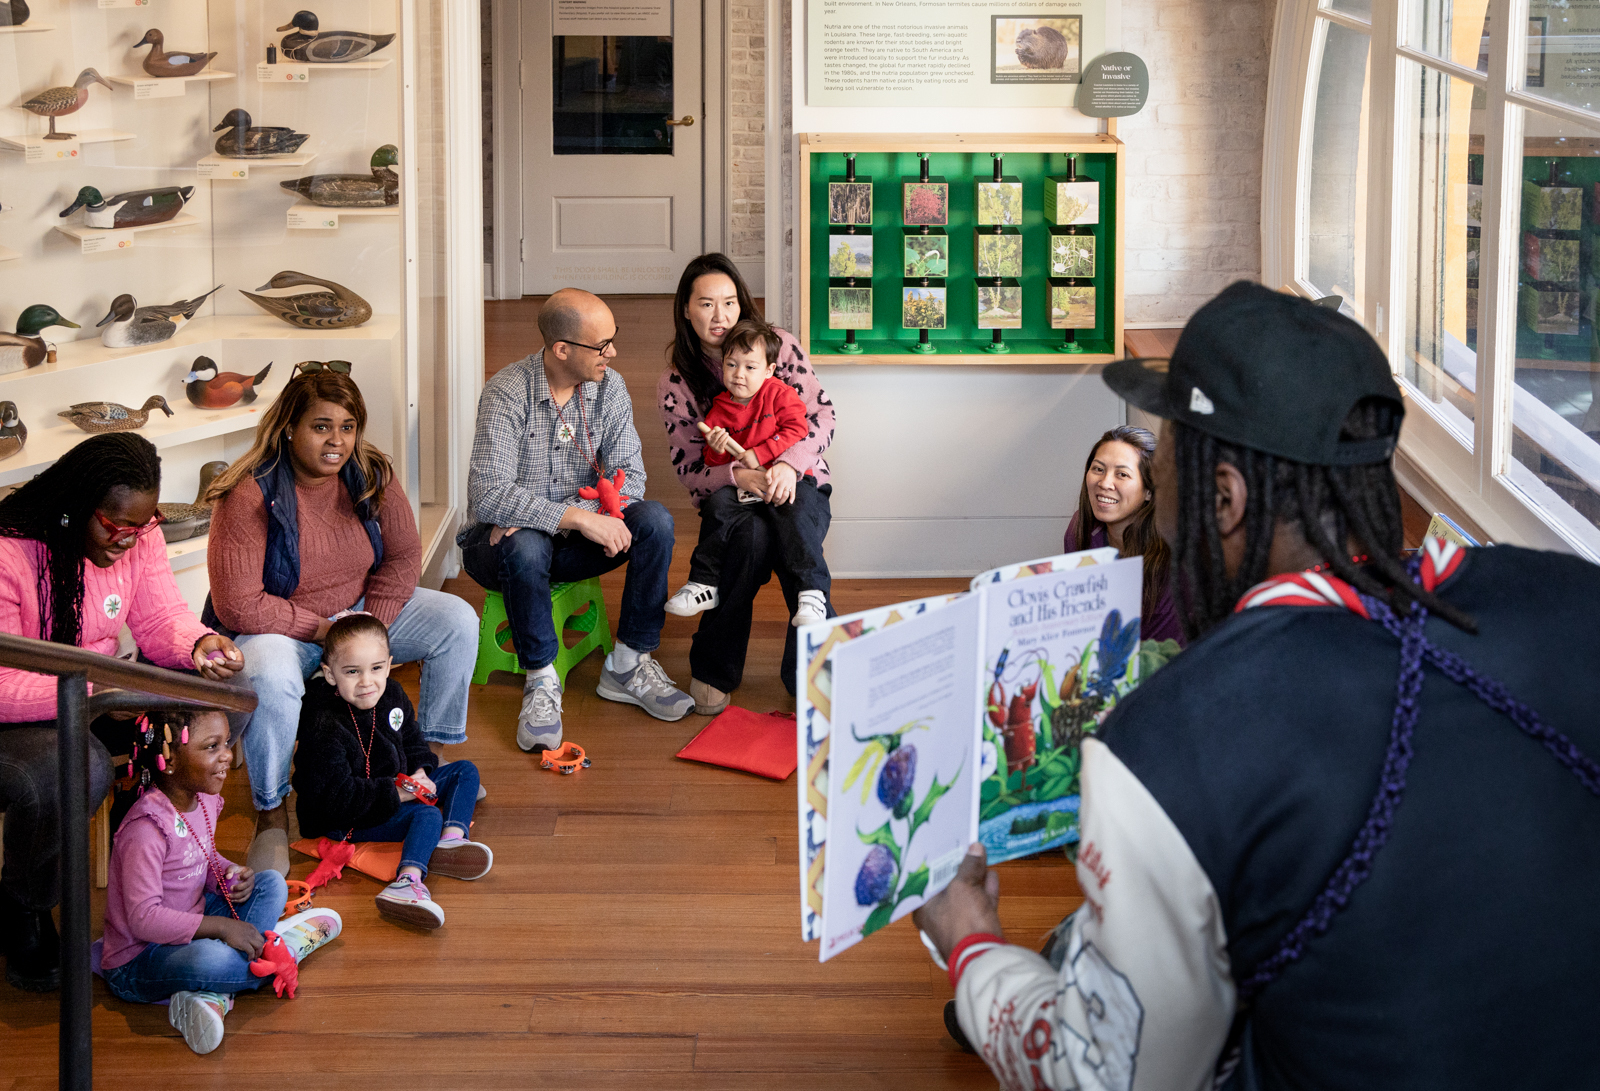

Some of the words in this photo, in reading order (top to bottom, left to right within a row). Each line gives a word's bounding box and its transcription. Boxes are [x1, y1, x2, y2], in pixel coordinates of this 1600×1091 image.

[1430, 520, 1439, 537] The
[1007, 586, 1049, 608] Clovis
[1053, 574, 1108, 599] Crawfish
[1009, 606, 1033, 627] and
[1038, 603, 1057, 622] His
[1060, 594, 1106, 617] Friends
[1017, 637, 1037, 647] Mary
[1041, 632, 1059, 641] Alice
